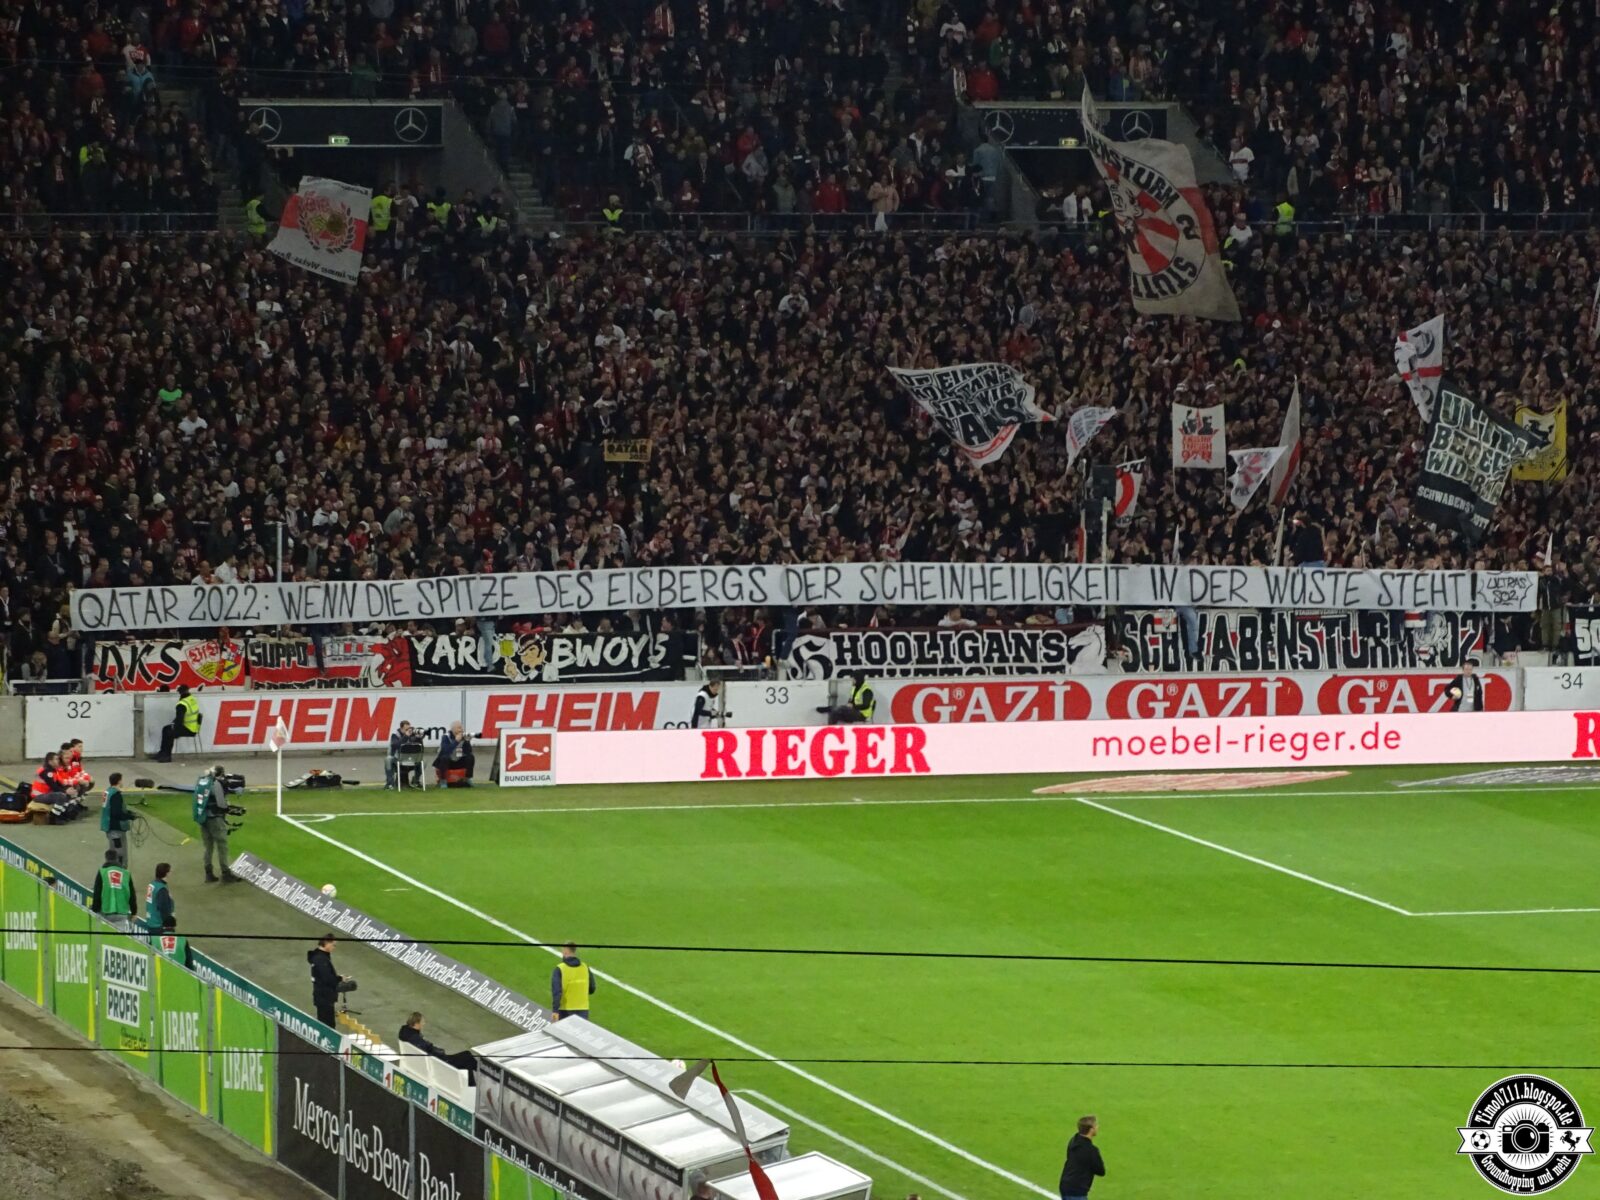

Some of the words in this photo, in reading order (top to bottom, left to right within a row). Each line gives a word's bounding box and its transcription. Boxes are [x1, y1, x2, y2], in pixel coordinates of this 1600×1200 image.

[79, 588, 179, 628] QATAR
[189, 586, 269, 622] 2022:
[279, 581, 357, 621] WENN
[365, 580, 410, 617] DIE
[417, 576, 519, 616] SPITZE
[535, 571, 594, 609] DES
[607, 566, 769, 606] EISBERGS
[785, 565, 842, 600] DER
[860, 564, 1129, 601] SCHEINHEILIGKEIT
[1150, 566, 1178, 601] IN
[1189, 568, 1249, 602] DER
[1264, 567, 1364, 606] WÜSTE
[1378, 571, 1479, 610] STEHT!
[830, 630, 1068, 666] HOOLIGANS
[67, 701, 92, 719] 32
[482, 691, 660, 739] EHEIM
[765, 687, 789, 704] 33
[213, 697, 397, 746] EHEIM
[700, 726, 931, 778] RIEGER
[1093, 722, 1401, 761] moebel-rieger.de
[5, 912, 37, 950] LIBARE
[270, 876, 296, 901] Bank
[332, 908, 362, 935] Bank
[400, 942, 427, 970] Bank
[470, 979, 500, 1007] Bank
[56, 944, 88, 983] LIBARE
[103, 950, 147, 988] ABBRUCH
[107, 987, 139, 1024] PROFIS
[162, 1011, 199, 1050] LIBARE
[223, 1046, 264, 1092] LIBARE
[294, 1077, 411, 1200] Mercedes-Benz
